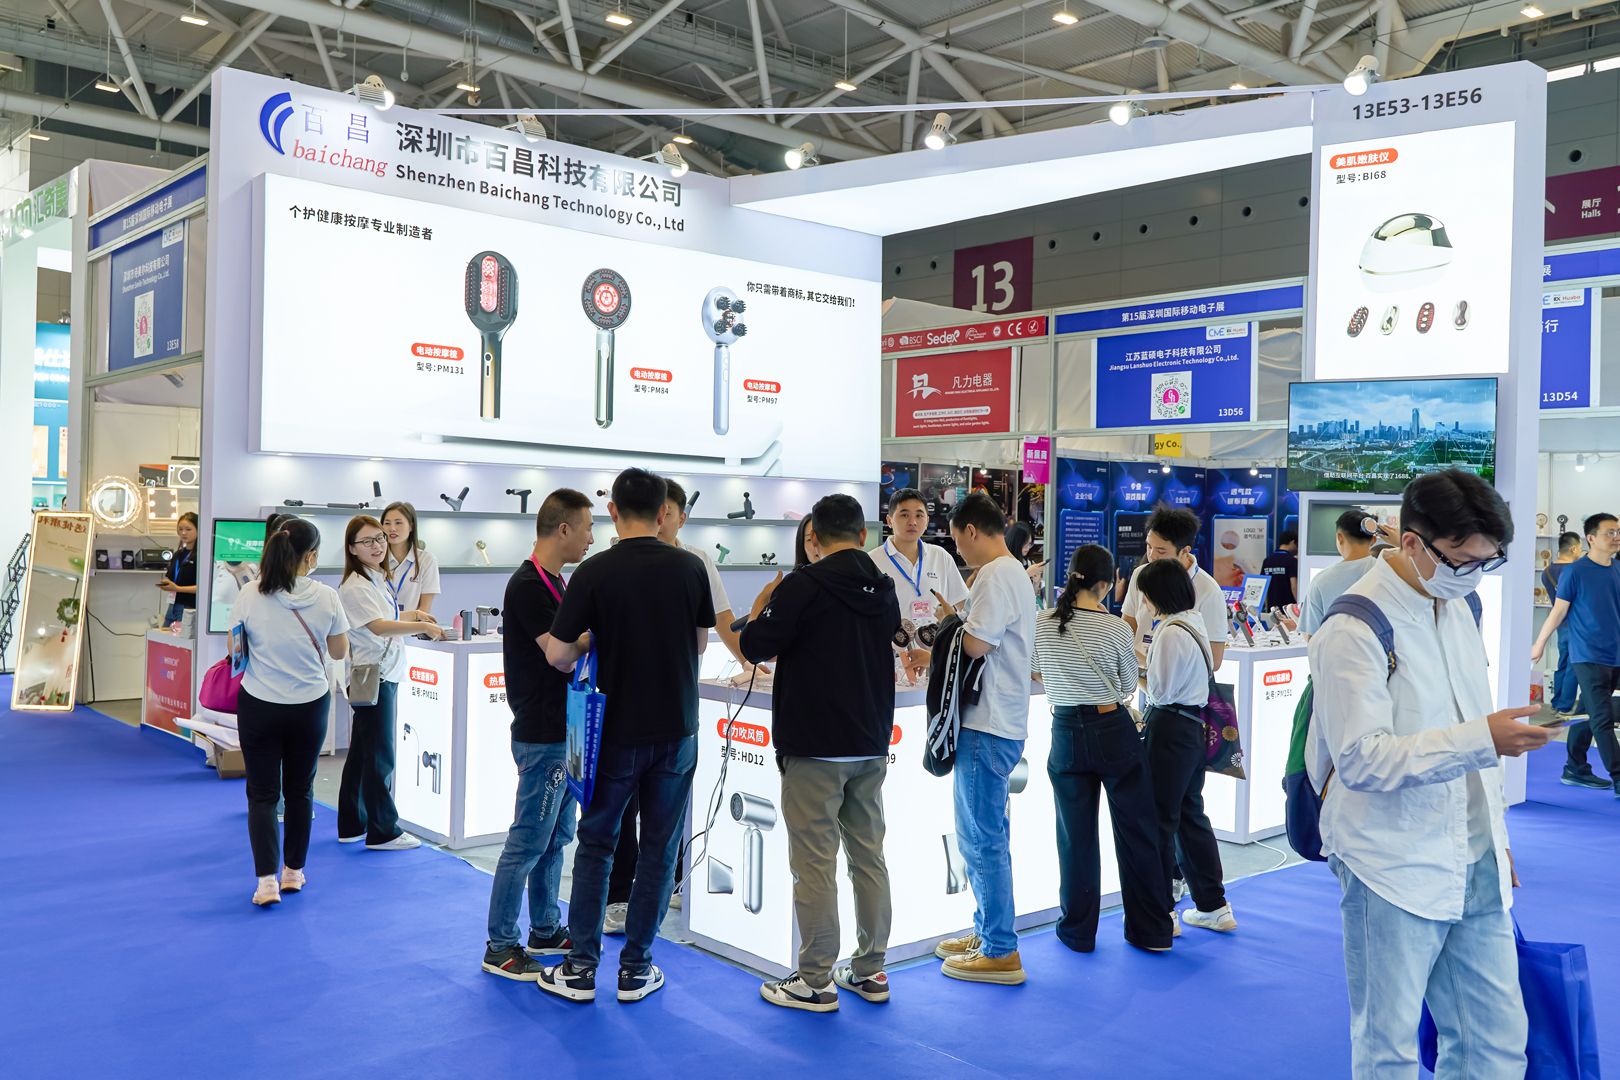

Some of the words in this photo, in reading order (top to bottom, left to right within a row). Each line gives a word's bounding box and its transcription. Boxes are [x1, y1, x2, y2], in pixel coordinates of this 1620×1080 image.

[1352, 87, 1482, 120] 13E53-13E56
[302, 103, 369, 143] 百昌
[292, 139, 389, 178] baichang
[396, 121, 681, 207] 深圳市百昌科技有限公司
[1335, 151, 1390, 168] 美肌嫩肤仪
[396, 164, 476, 192] Shenzhen
[479, 180, 550, 210] Baichang
[553, 195, 633, 225] Technology
[663, 216, 685, 232] Ltd
[1581, 197, 1602, 209] 展厅
[1581, 209, 1601, 219] Halls
[289, 205, 433, 241] 个护健康按摩专业制造者
[971, 260, 1015, 313] 13
[1121, 302, 1225, 322] 第15届深圳国际移动电子展
[166, 338, 179, 351] 13E58
[927, 330, 960, 345] Sedex
[1125, 344, 1221, 361] 江苏蓝硕电子科技有限公司
[1130, 361, 1153, 369] Lanshuo
[1153, 359, 1182, 367] Electronic
[1182, 357, 1215, 366] Technology
[952, 372, 993, 389] 凡力电器
[1542, 391, 1578, 402] 13D54
[1218, 407, 1244, 417] 13D56
[1026, 449, 1047, 460] 新展商
